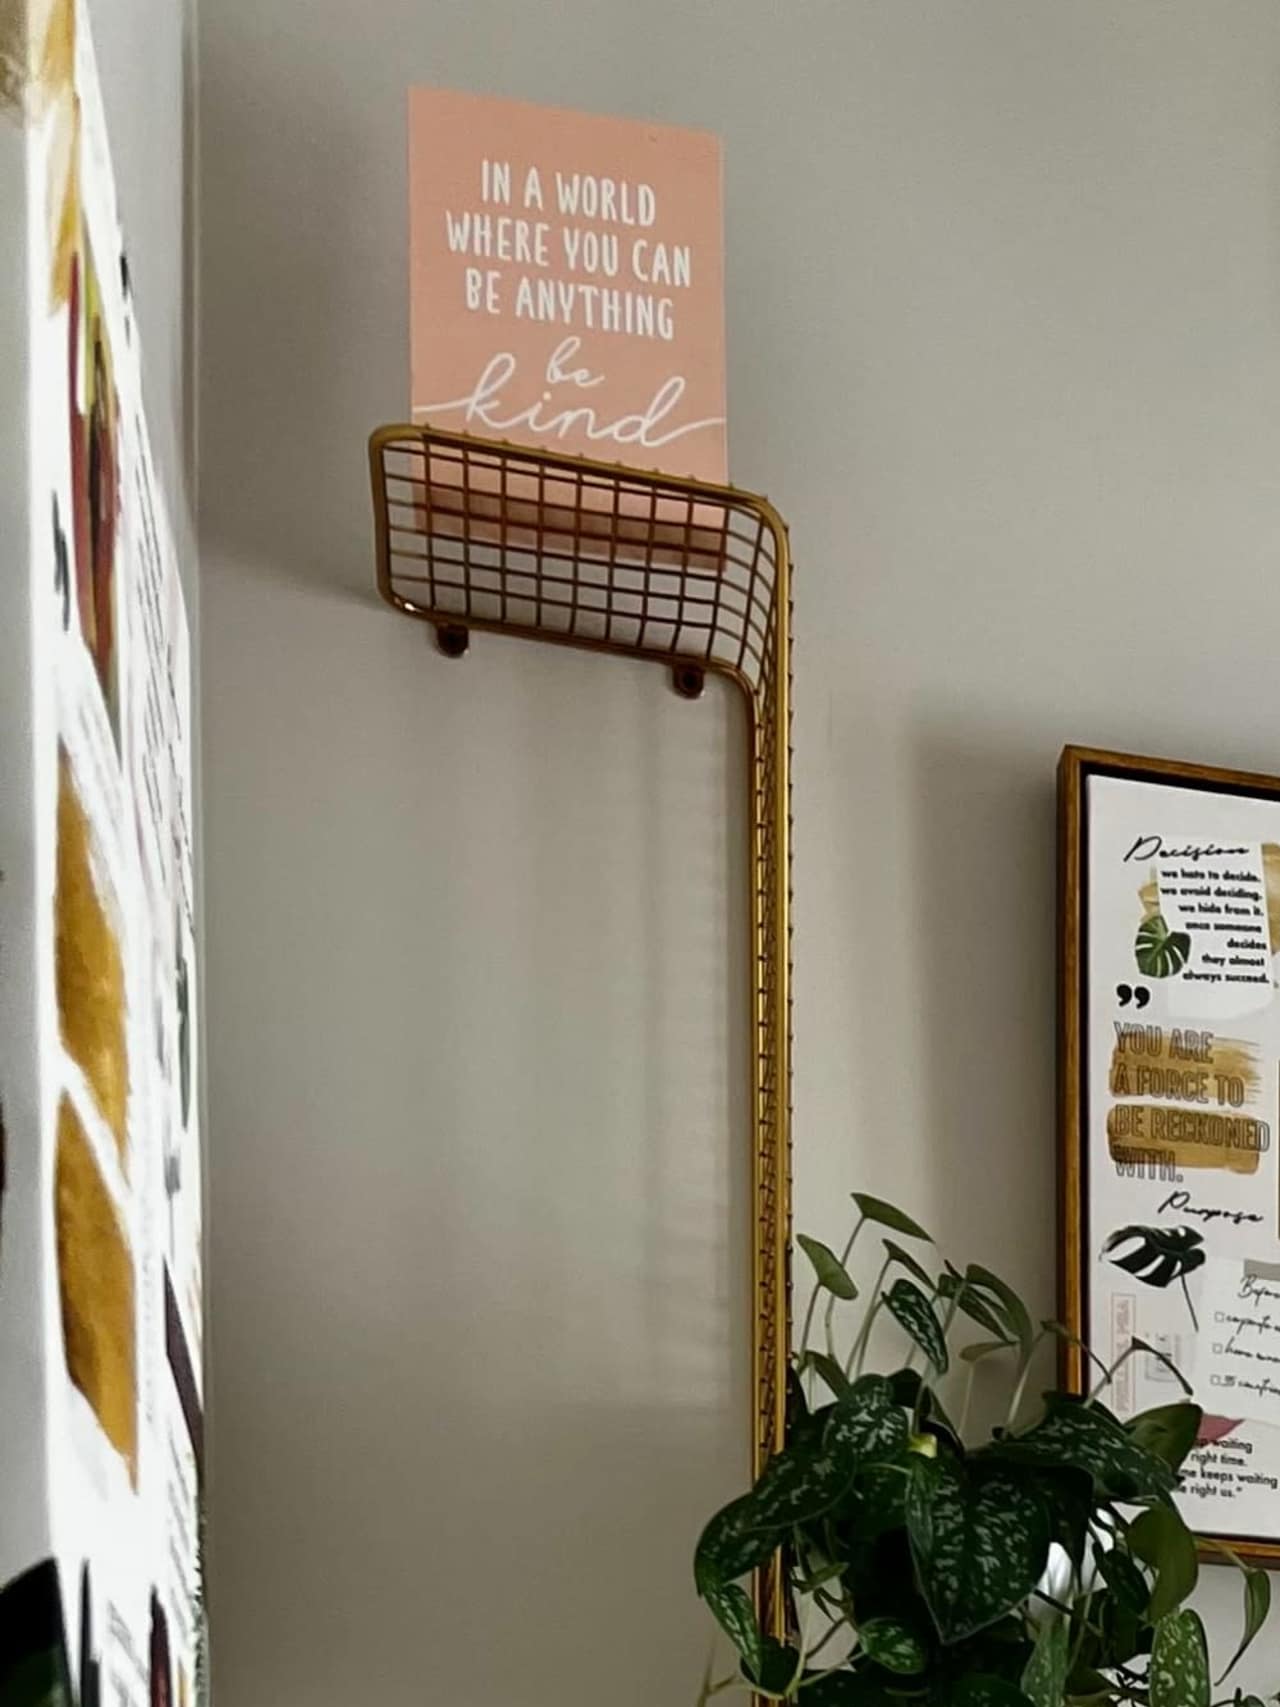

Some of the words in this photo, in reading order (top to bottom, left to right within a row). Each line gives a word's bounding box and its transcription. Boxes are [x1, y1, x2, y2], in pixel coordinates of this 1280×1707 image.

[482, 158, 510, 205] IN
[524, 166, 543, 210] A
[556, 171, 656, 227] WORLD
[446, 209, 549, 267] WHERE
[563, 227, 618, 277] YOU
[633, 240, 690, 288] CAN
[466, 268, 500, 314] BE
[516, 277, 674, 340] ANYTHING
[547, 336, 604, 387] be
[413, 353, 726, 447] kind
[1114, 1021, 1162, 1057] YOU
[1169, 1029, 1214, 1064] ARE
[1114, 1063, 1130, 1096] A
[1137, 1066, 1209, 1104] FORCE
[1215, 1074, 1244, 1108] TO
[1115, 1104, 1144, 1138] BE
[1152, 1108, 1270, 1152] RECKONED
[1113, 1146, 1184, 1182] WITH.
